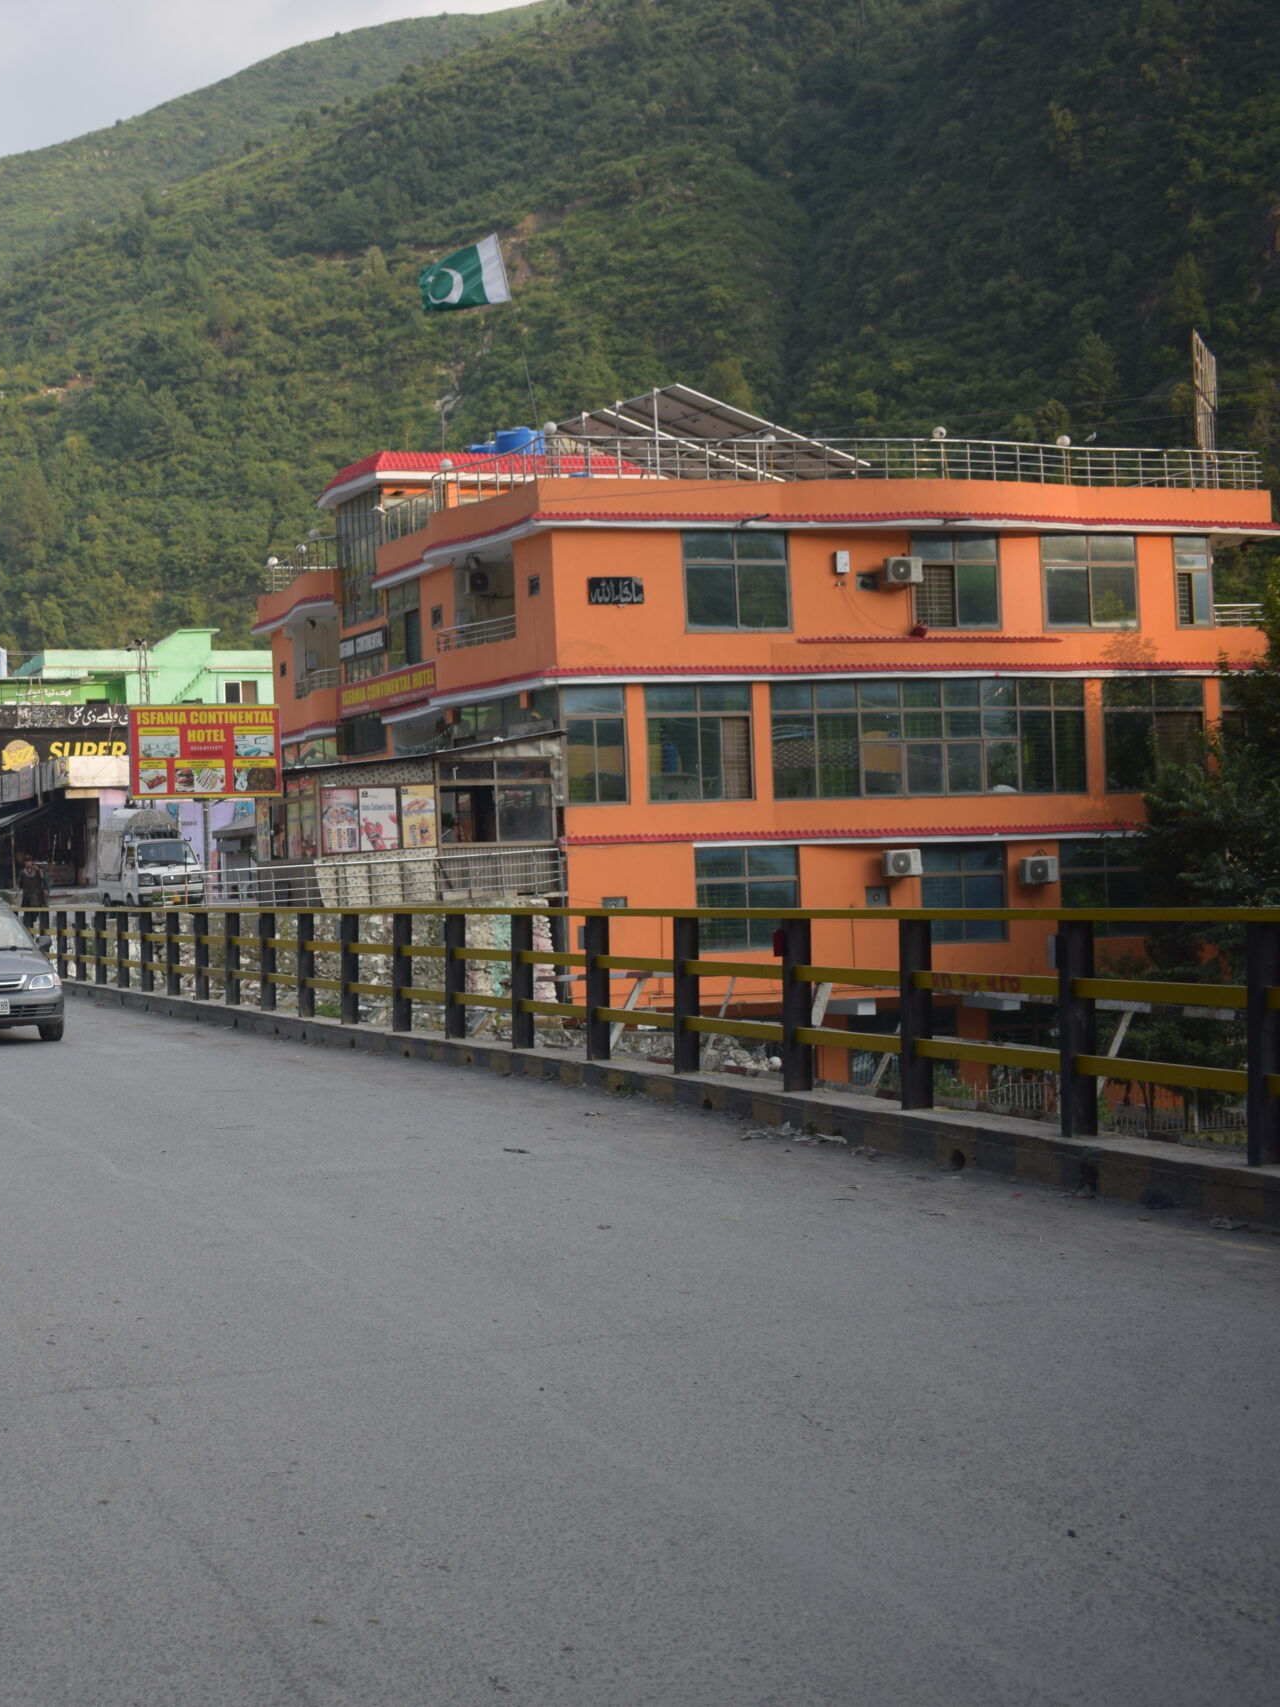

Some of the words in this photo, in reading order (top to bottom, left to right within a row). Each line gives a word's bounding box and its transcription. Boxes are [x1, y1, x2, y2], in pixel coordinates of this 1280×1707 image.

[367, 674, 412, 701] CONTINENTAL
[136, 710, 187, 725] ISFANIA
[189, 710, 275, 724] CONTINENTAL
[187, 729, 226, 743] HOTEL
[49, 741, 127, 758] SUPER
